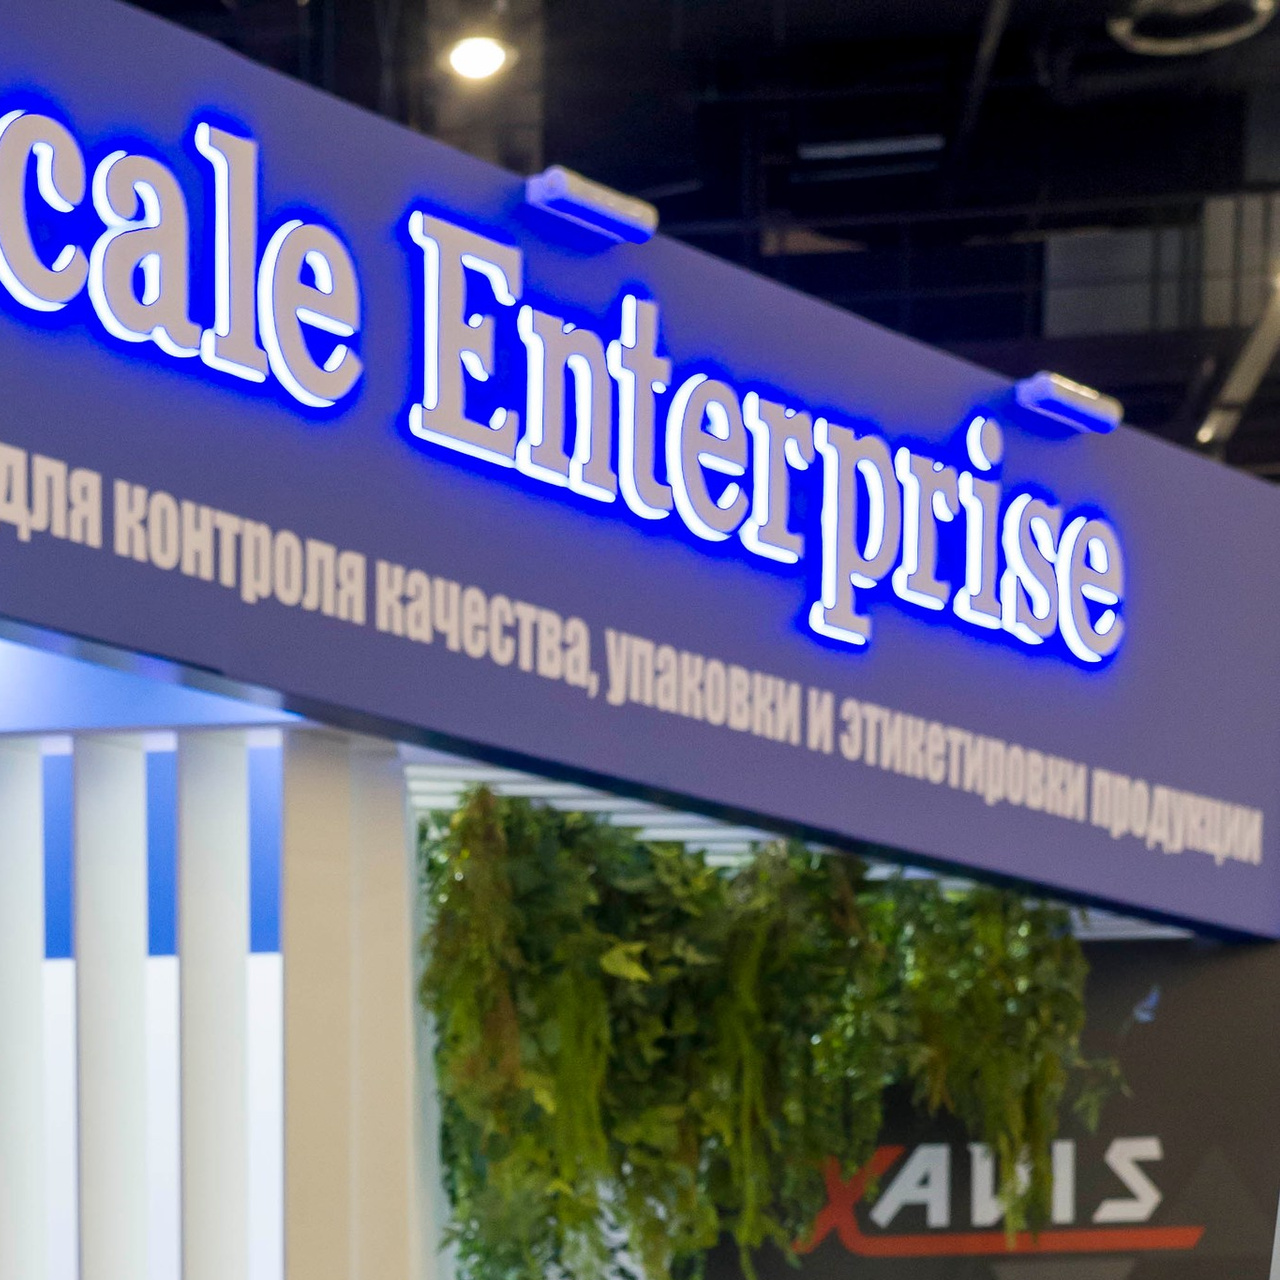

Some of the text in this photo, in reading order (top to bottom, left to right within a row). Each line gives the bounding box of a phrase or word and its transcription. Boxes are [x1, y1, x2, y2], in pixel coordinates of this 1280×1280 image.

[407, 208, 1126, 665] Enterprise
[113, 477, 367, 626] контроля
[375, 559, 600, 699] качества,
[604, 628, 802, 748] упаковки
[806, 687, 835, 755] и
[839, 697, 1089, 825] этикетировки
[1090, 767, 1264, 867] продукции
